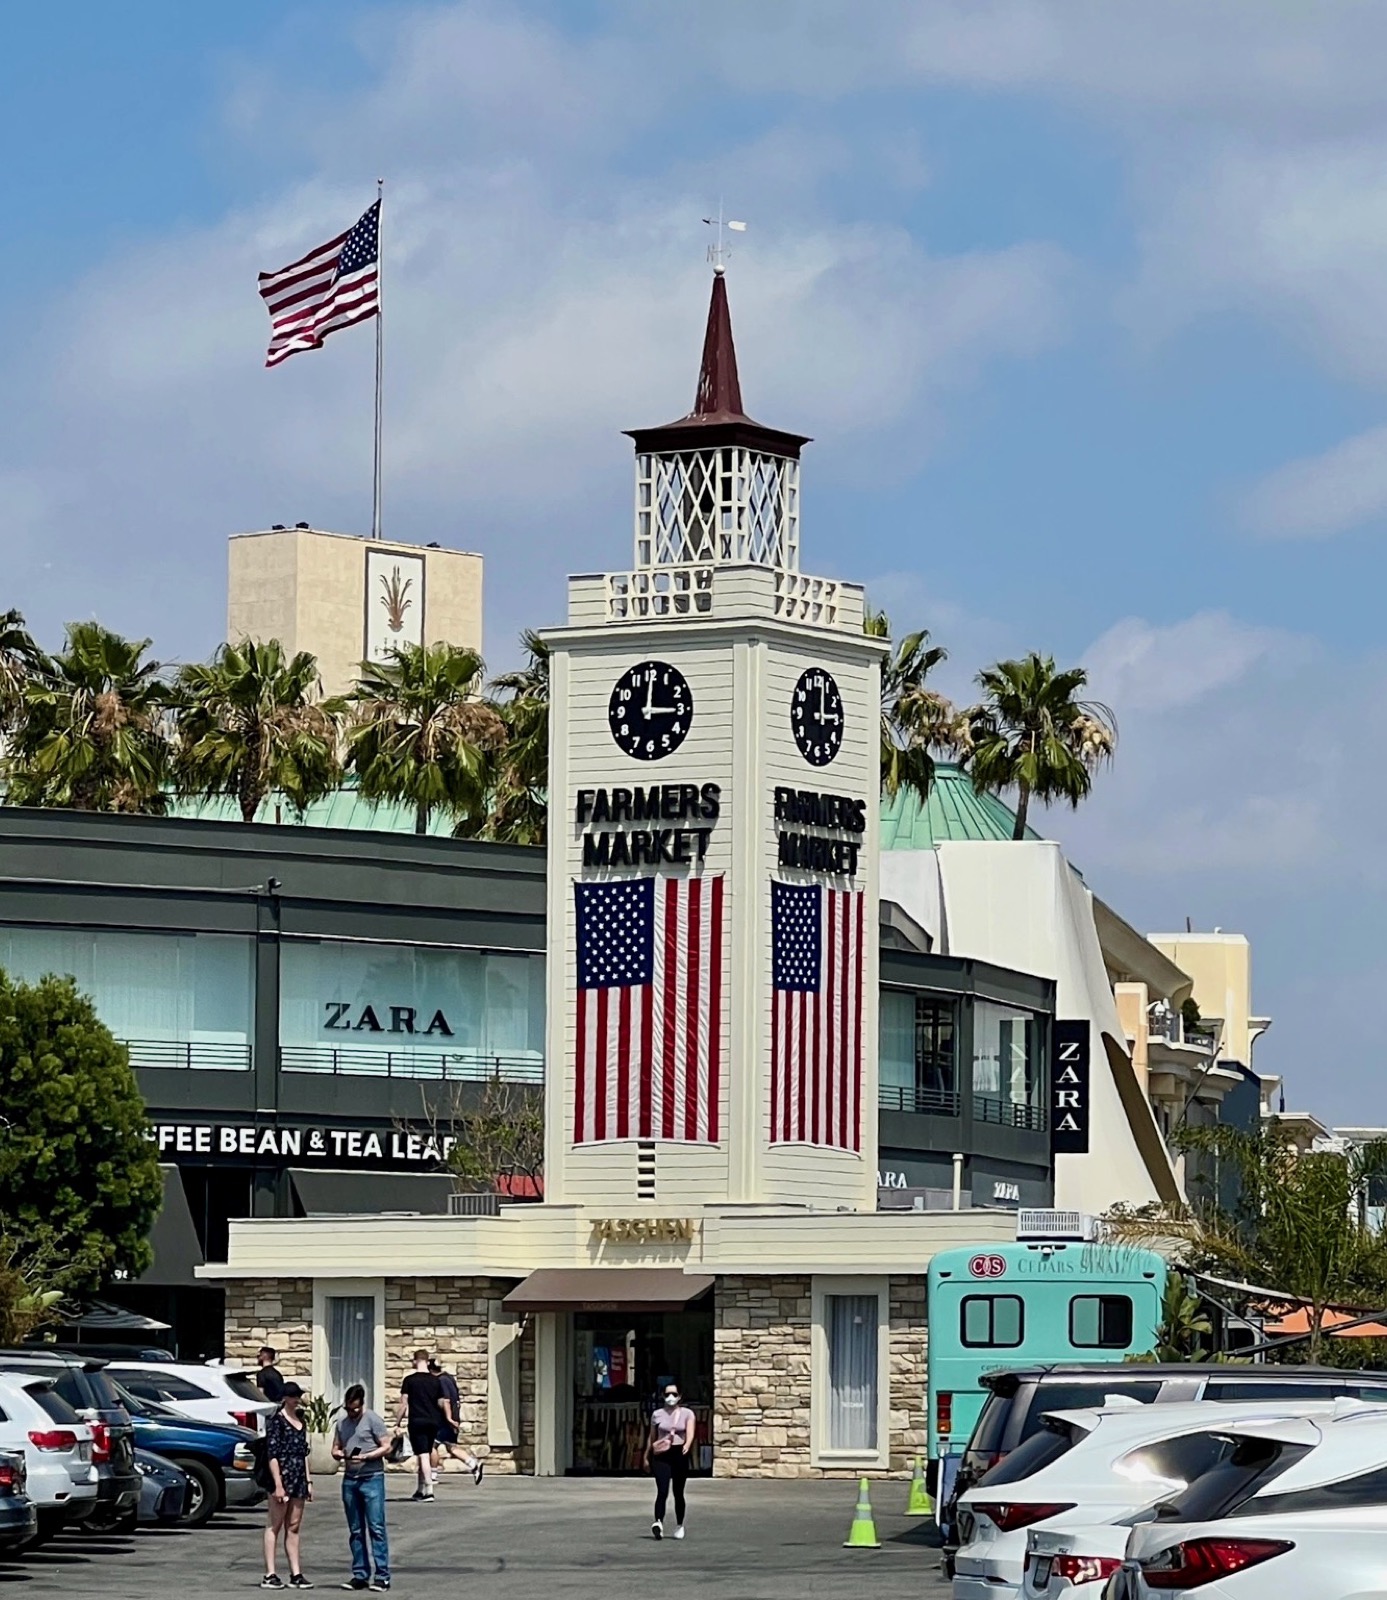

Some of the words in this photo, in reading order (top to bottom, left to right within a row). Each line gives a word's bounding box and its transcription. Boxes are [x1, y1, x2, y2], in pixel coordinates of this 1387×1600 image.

[632, 674, 641, 687] 11
[645, 669, 657, 682] 12
[663, 673, 668, 685] 1
[813, 675, 823, 688] 12
[805, 677, 813, 691] 11
[825, 681, 830, 694] 1
[620, 689, 631, 701] 10
[673, 685, 682, 698] 2
[676, 702, 685, 715] 3
[831, 696, 837, 708] 2
[617, 706, 626, 718] 9
[796, 706, 803, 720] 9
[620, 724, 629, 736] 8
[671, 721, 681, 734] 4
[632, 736, 641, 748] 7
[661, 734, 670, 747] 5
[830, 731, 836, 744] 4
[646, 740, 655, 752] 6
[806, 740, 812, 752] 7
[814, 745, 820, 757] 6
[824, 742, 831, 755] 5
[577, 782, 721, 823] FARMERS
[583, 827, 712, 867] MARKET
[323, 1002, 455, 1036] ZARA
[1055, 1042, 1082, 1131] ZARA
[142, 1126, 212, 1153] FFEE
[219, 1127, 301, 1156] BEAN
[308, 1131, 326, 1154] &
[331, 1132, 383, 1158] TEA
[392, 1133, 458, 1161] LEAF
[876, 1170, 909, 1189] ARA
[589, 1218, 694, 1239] TASCHEN
[1017, 1257, 1075, 1274] CEDARS
